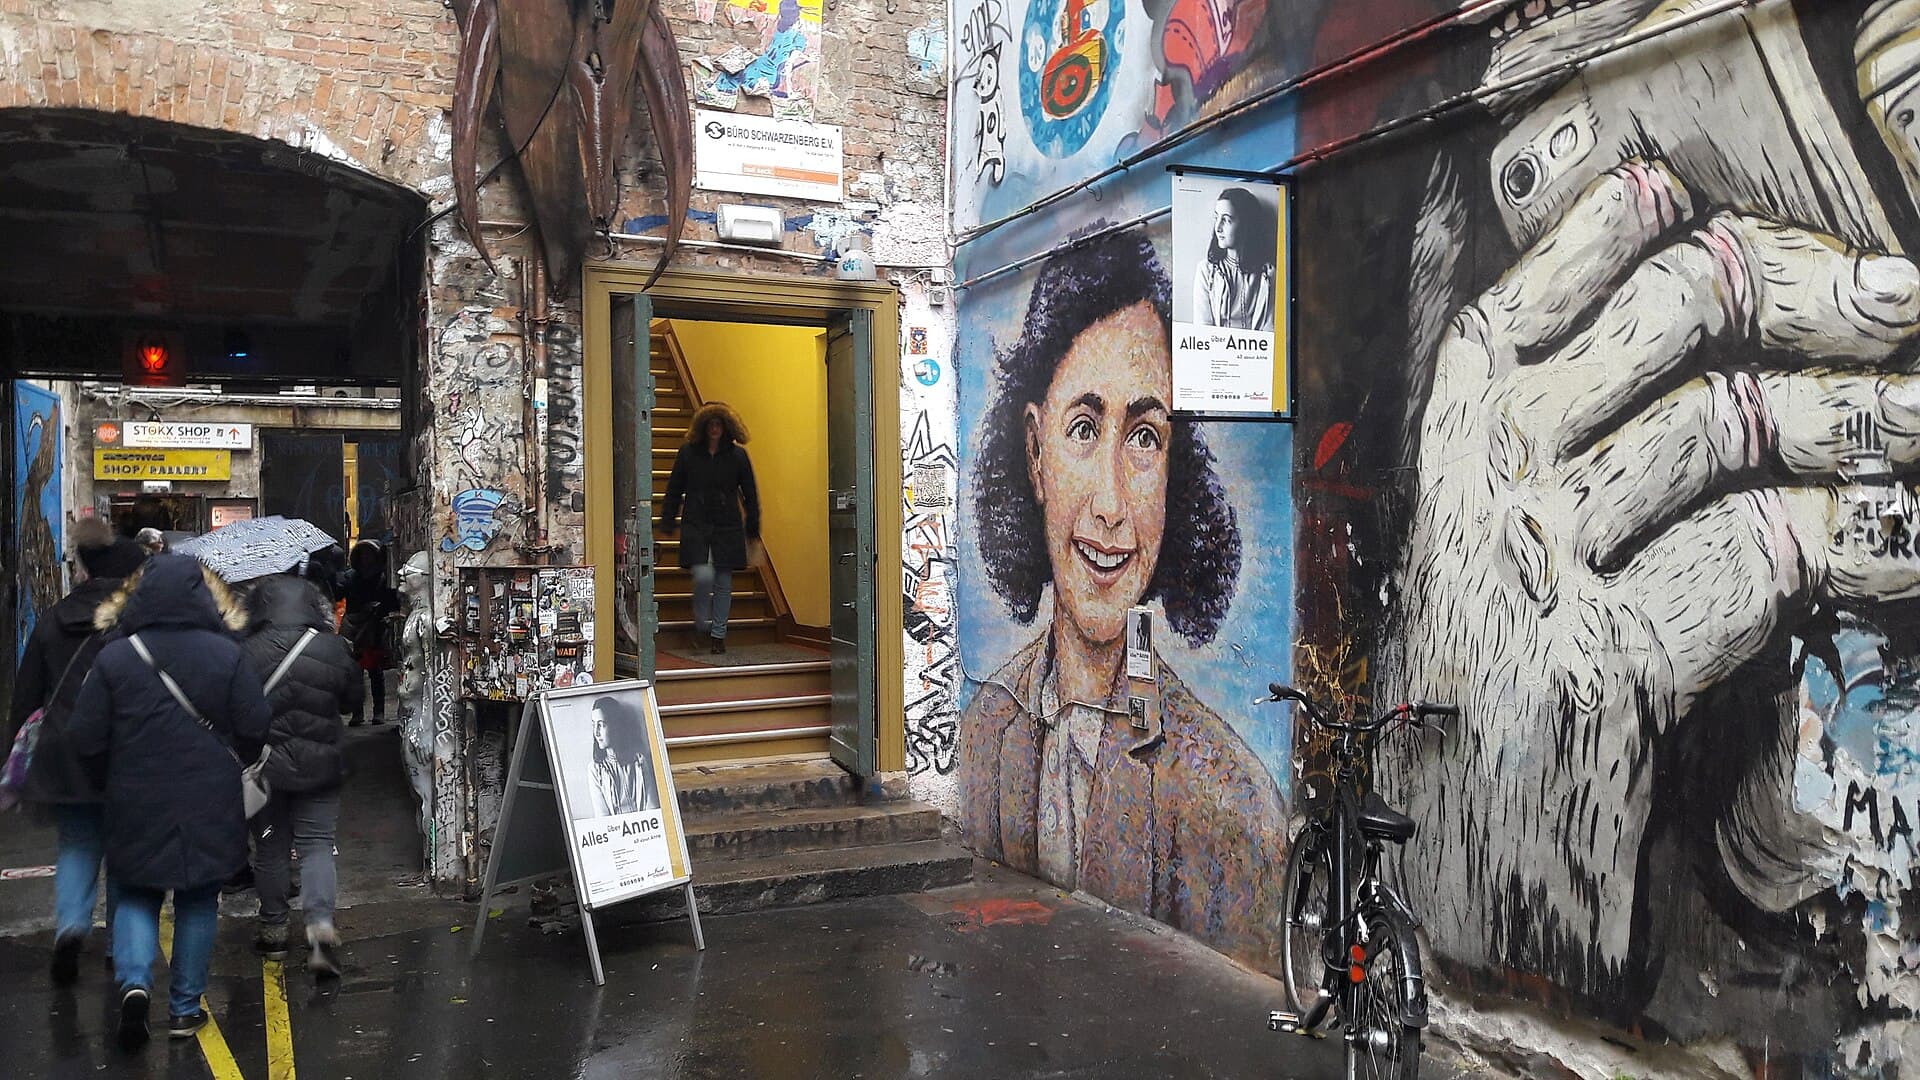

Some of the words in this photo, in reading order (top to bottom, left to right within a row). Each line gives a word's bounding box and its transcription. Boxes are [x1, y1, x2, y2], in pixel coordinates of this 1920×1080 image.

[727, 125, 750, 140] BÜRO
[751, 129, 819, 148] SCHWARZENBERG
[1180, 336, 1210, 351] Alles
[1211, 335, 1226, 343] über
[1226, 334, 1268, 351] Anne
[133, 425, 174, 436] STOKX
[178, 426, 210, 437] SHOP
[582, 830, 609, 848] Alles
[607, 825, 621, 833] über
[622, 817, 659, 837] Anne
